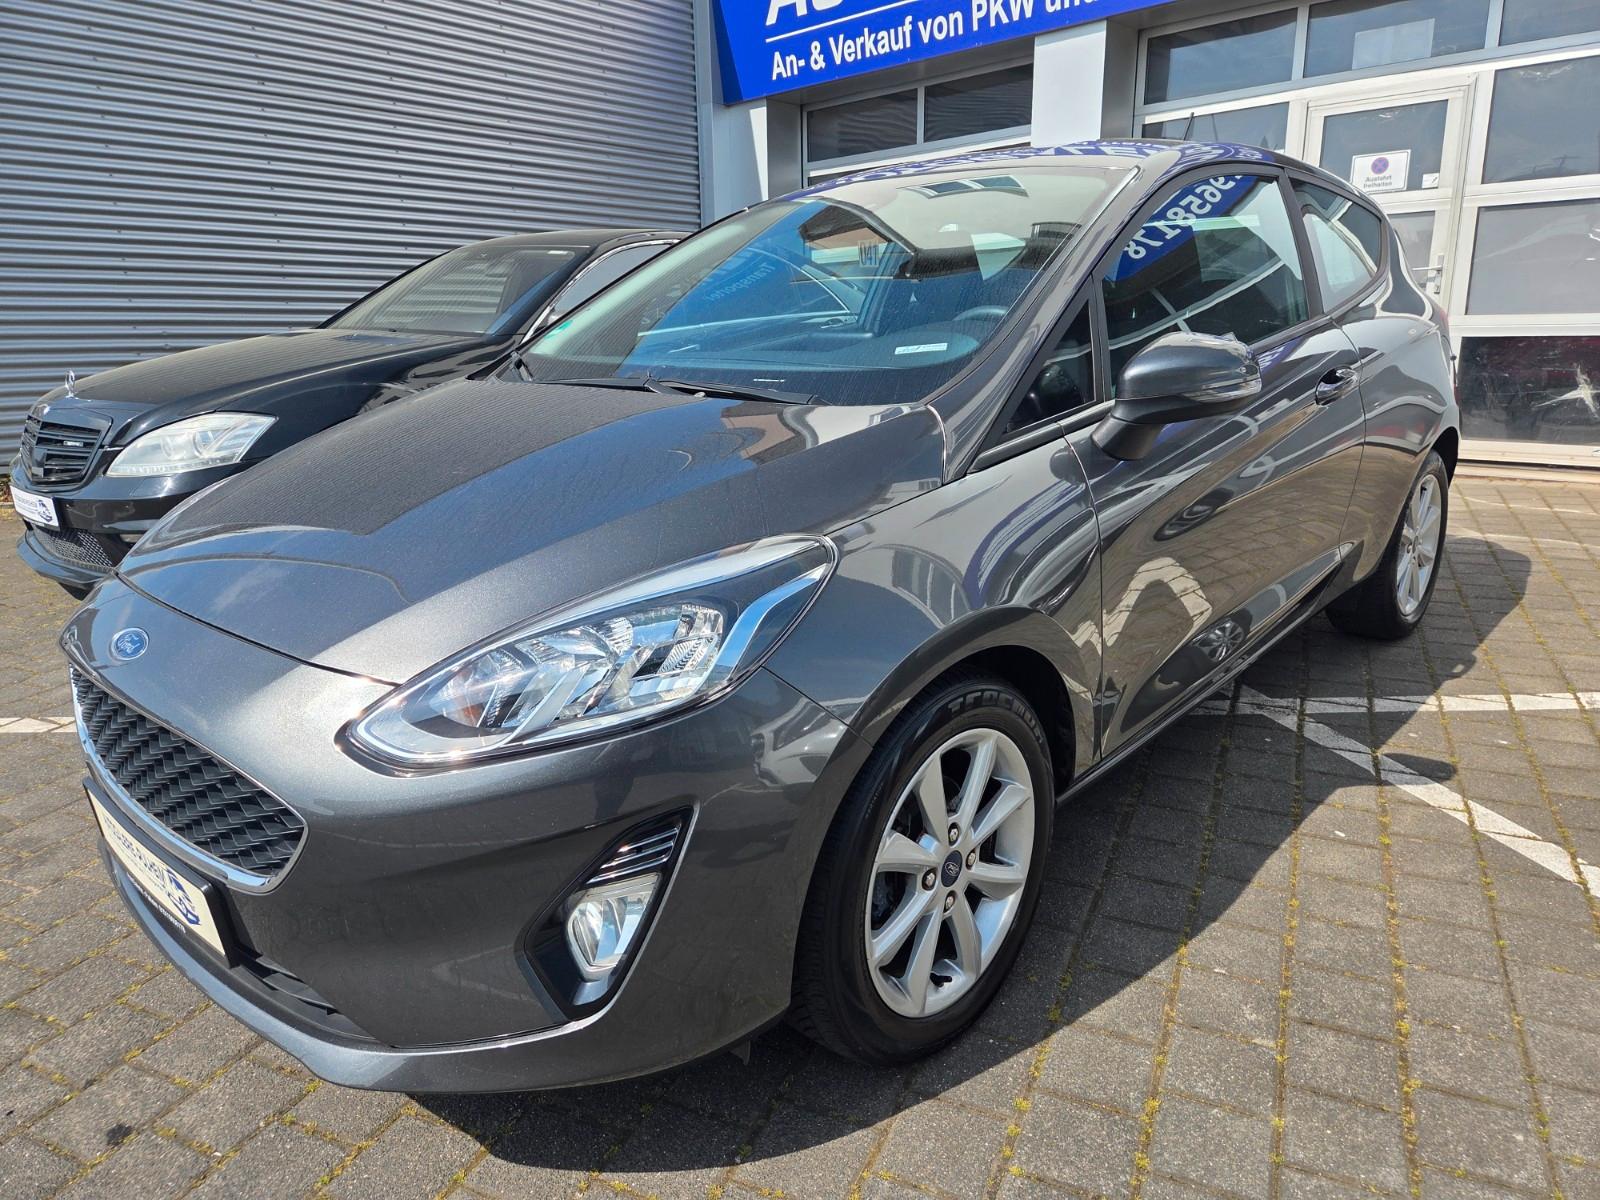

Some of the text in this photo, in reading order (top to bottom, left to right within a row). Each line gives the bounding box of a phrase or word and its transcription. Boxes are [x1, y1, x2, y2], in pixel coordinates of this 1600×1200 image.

[771, 51, 806, 81] An-
[809, 40, 826, 71] &
[829, 15, 913, 66] Verkauf
[918, 10, 963, 44] von
[971, 0, 1034, 32] PKW
